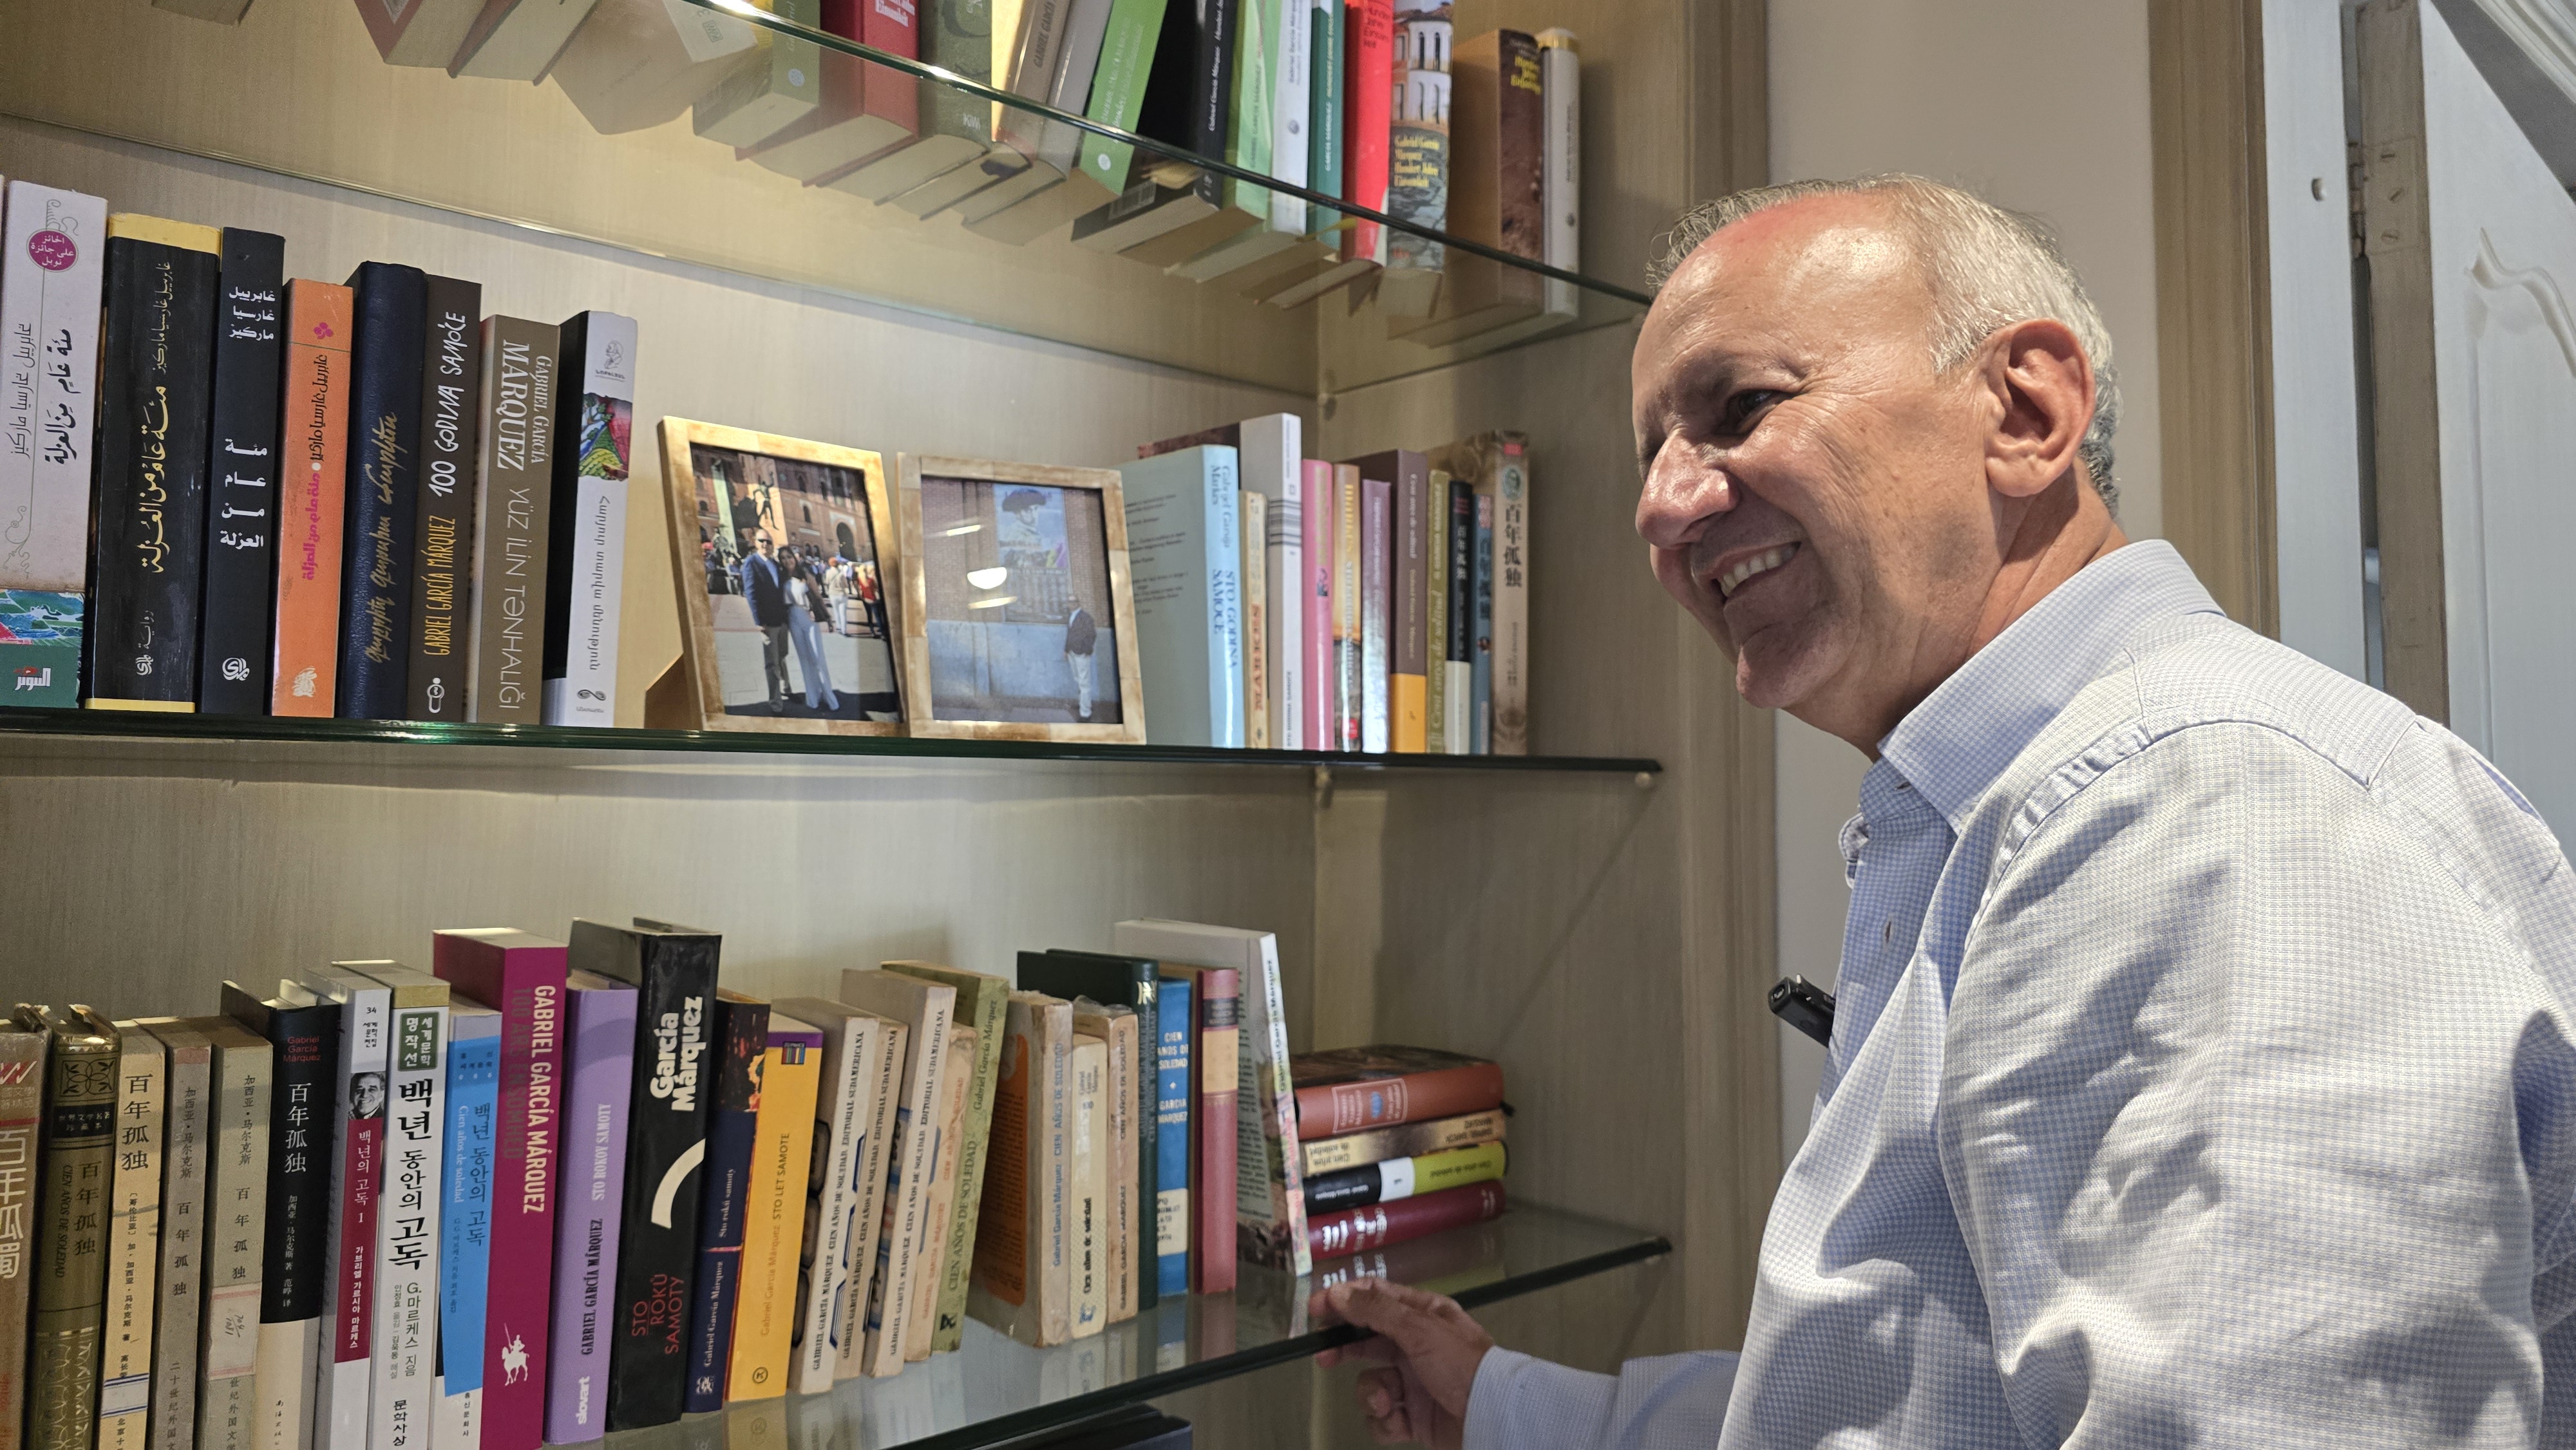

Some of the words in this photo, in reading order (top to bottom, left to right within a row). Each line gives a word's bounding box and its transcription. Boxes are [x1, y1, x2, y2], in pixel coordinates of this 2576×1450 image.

[437, 312, 468, 375] SAMOĆE
[534, 355, 553, 412] GABRIEL
[434, 385, 464, 451] GODINA
[531, 415, 549, 464] GARCÍA
[428, 460, 457, 498] 100
[507, 488, 534, 529] YÜZ
[421, 515, 457, 568] MÁRQUEZ
[506, 537, 532, 576] İLİN
[421, 573, 454, 610] GARCÍA
[423, 615, 452, 655] GABRIEL
[287, 1035, 319, 1044] Gabriel
[531, 984, 556, 1057] GABRIEL
[982, 999, 998, 1041] Márquez
[1164, 1031, 1183, 1042] CIEN
[404, 1017, 419, 1067] 명작선
[420, 1017, 433, 1066] 세계문학
[650, 1012, 679, 1099] García
[671, 995, 706, 1111] Márquez
[927, 1008, 945, 1077] SUDAMERICANA
[978, 1042, 991, 1075] García
[848, 1030, 864, 1099] SUDAMERICANA
[1054, 1042, 1063, 1086] SOLEDAD
[1159, 1058, 1188, 1070] SOLEDAD
[397, 1078, 434, 1141] 백년
[527, 1062, 554, 1127] GARCÍA
[973, 1073, 986, 1111] Gabriel
[1054, 1087, 1063, 1099] DE
[121, 1073, 153, 1171] 百年孤独
[283, 1082, 312, 1173] 百年孤独
[458, 1105, 469, 1128] Cien
[473, 1102, 491, 1141] 백년
[596, 1104, 612, 1144] SAMOTY
[356, 1130, 372, 1174] 백년의
[456, 1129, 468, 1152] años
[456, 1153, 466, 1165] de
[776, 1133, 790, 1178] SAMOTE
[1054, 1133, 1063, 1156] CIEN
[399, 1149, 427, 1211] 동안의
[469, 1146, 489, 1203] 동안의
[523, 1131, 553, 1214] MÁRQUEZ
[592, 1145, 609, 1180] ROKOV
[961, 1140, 978, 1198] SOLEDAD
[354, 1179, 370, 1206] 고독
[453, 1167, 466, 1203] soledad
[591, 1180, 607, 1201] STO
[773, 1178, 785, 1198] LET
[73, 1160, 102, 1256] 百年孤独
[358, 1213, 364, 1223] 1
[466, 1209, 487, 1247] 고독
[772, 1198, 783, 1221] STO
[958, 1201, 968, 1219] DE
[173, 1201, 193, 1296] 百年孤独
[232, 1187, 251, 1280] 百年孤独
[388, 1217, 429, 1270] 고독
[584, 1218, 603, 1266] MÁRQUEZ
[717, 1222, 728, 1238] Sto
[354, 1246, 364, 1279] 가브리엘
[948, 1259, 961, 1292] CIEN
[352, 1281, 362, 1313] 가르시아
[583, 1268, 600, 1308] GARCÍA
[650, 1273, 668, 1326] ROKŮ
[350, 1317, 361, 1349] 마르케스
[582, 1308, 596, 1356] GABRIEL
[632, 1301, 648, 1337] STO
[665, 1276, 685, 1355] SAMOTY
[760, 1301, 773, 1337] Gabriel
[404, 1355, 417, 1377] 지음
[703, 1333, 715, 1368] Gabriel
[576, 1376, 590, 1425] slovart
[393, 1399, 408, 1447] 문학사상
